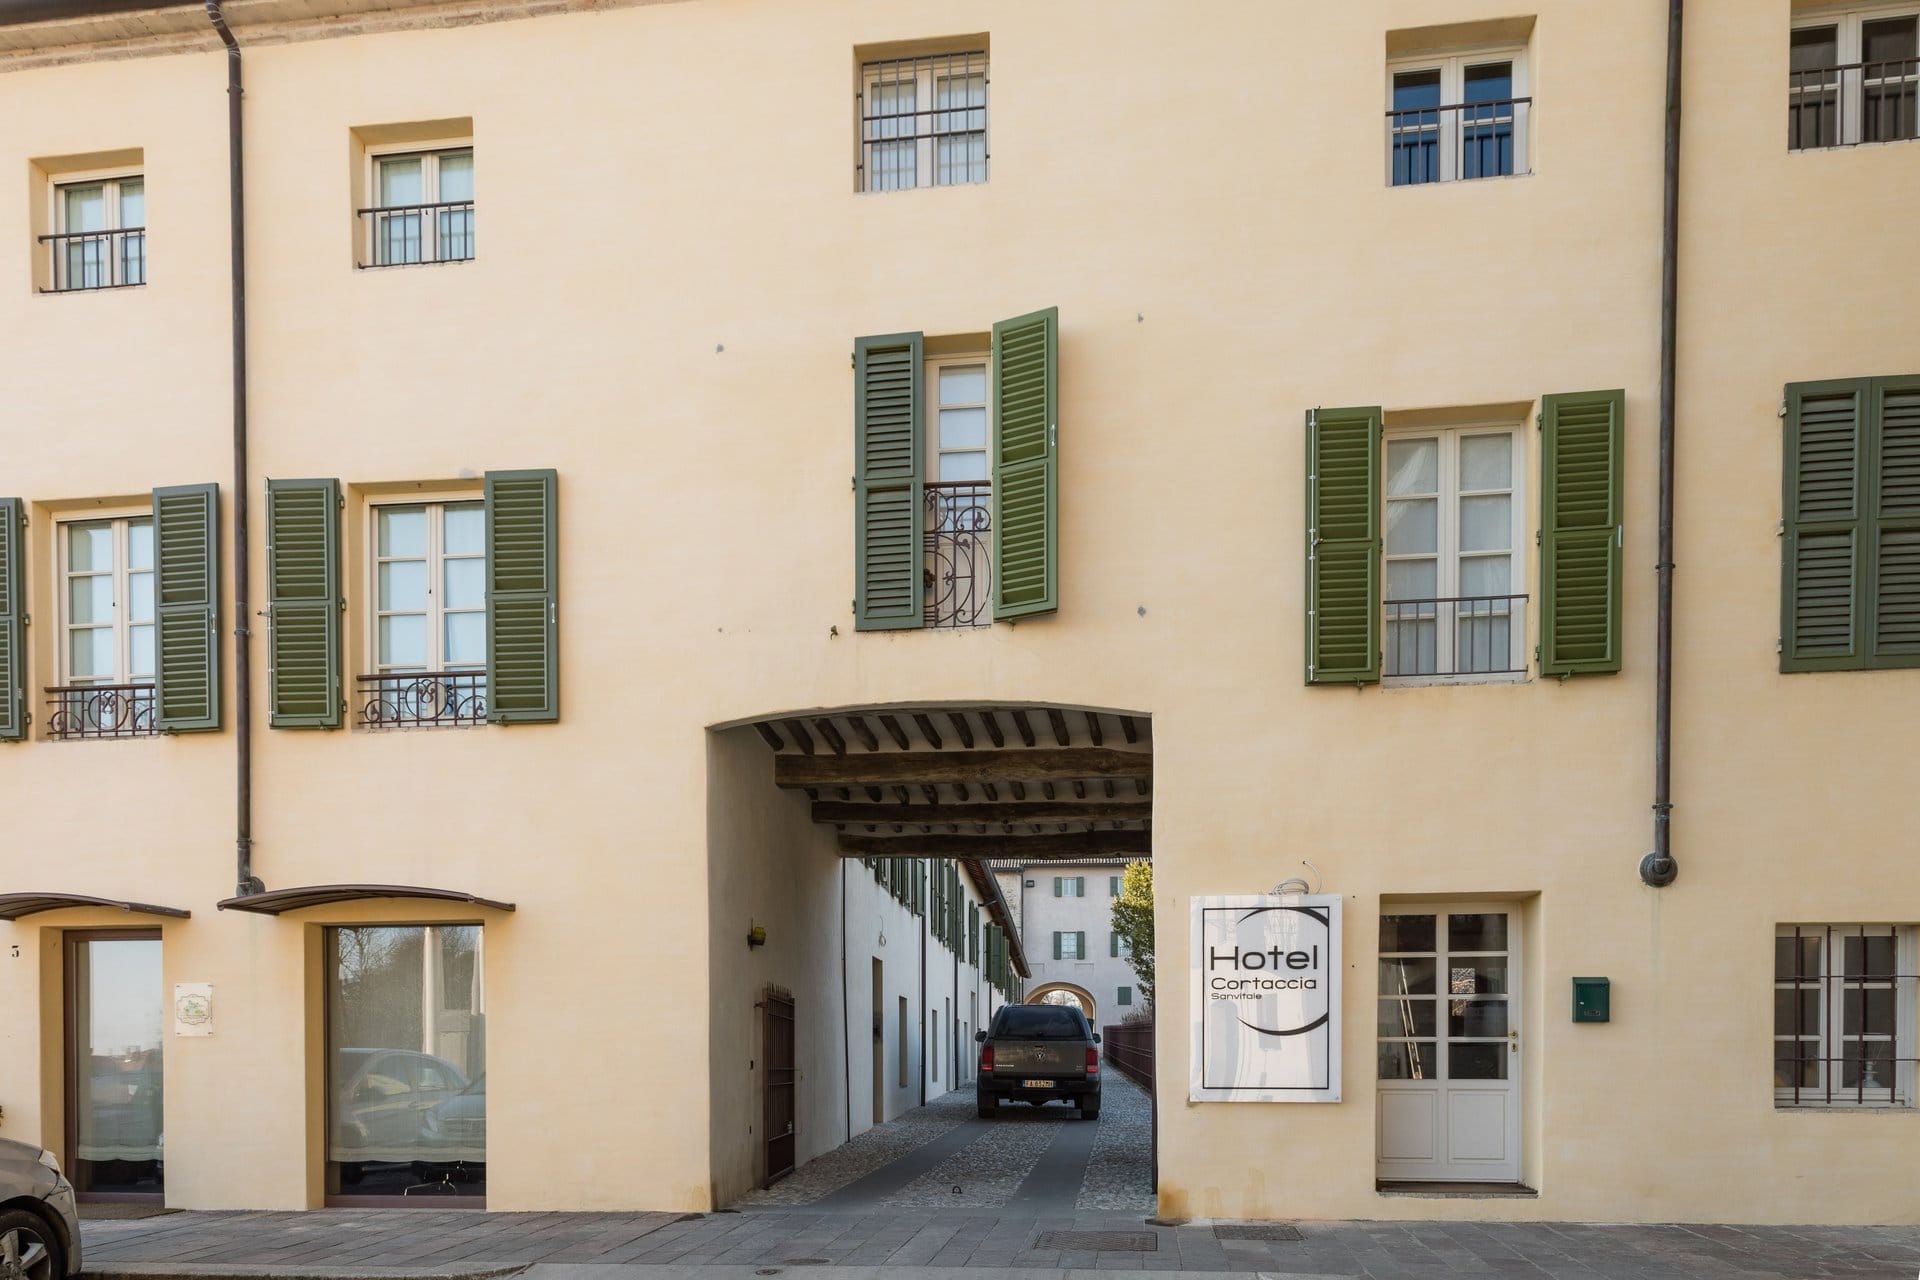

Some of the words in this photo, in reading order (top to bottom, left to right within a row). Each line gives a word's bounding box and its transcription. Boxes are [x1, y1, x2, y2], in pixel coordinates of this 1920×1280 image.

[1210, 945, 1318, 970] Hotel
[1211, 976, 1317, 990] Cortaccia
[1211, 992, 1263, 1001] Sanvitale
